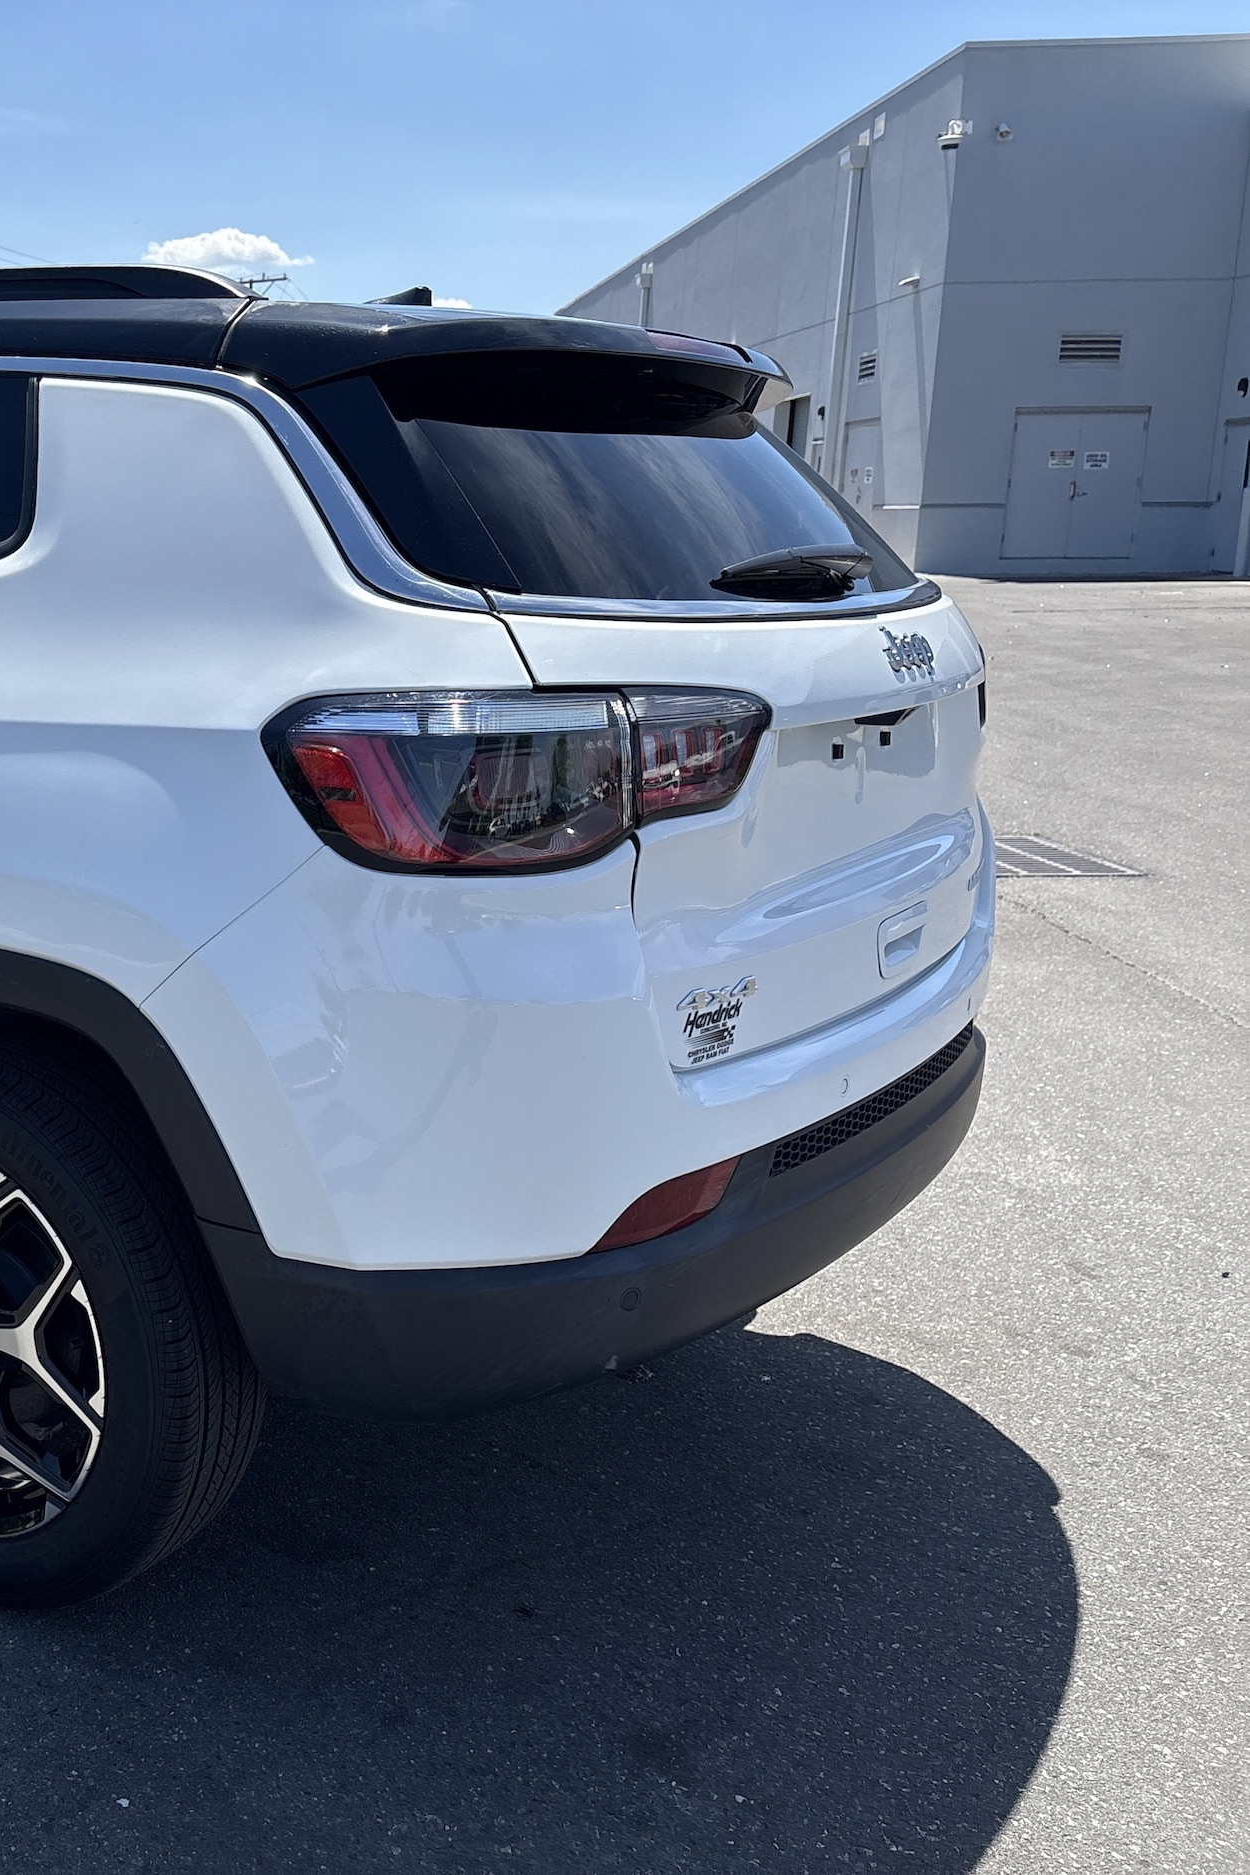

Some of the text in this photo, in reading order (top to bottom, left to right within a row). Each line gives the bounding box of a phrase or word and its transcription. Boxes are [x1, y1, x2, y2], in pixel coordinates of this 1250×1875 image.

[878, 626, 936, 676] Jeep
[683, 998, 743, 1038] Hendrick
[688, 1038, 735, 1058] CHRYSLER DODGE
[691, 1047, 730, 1064] JEEP RAM FIAT
